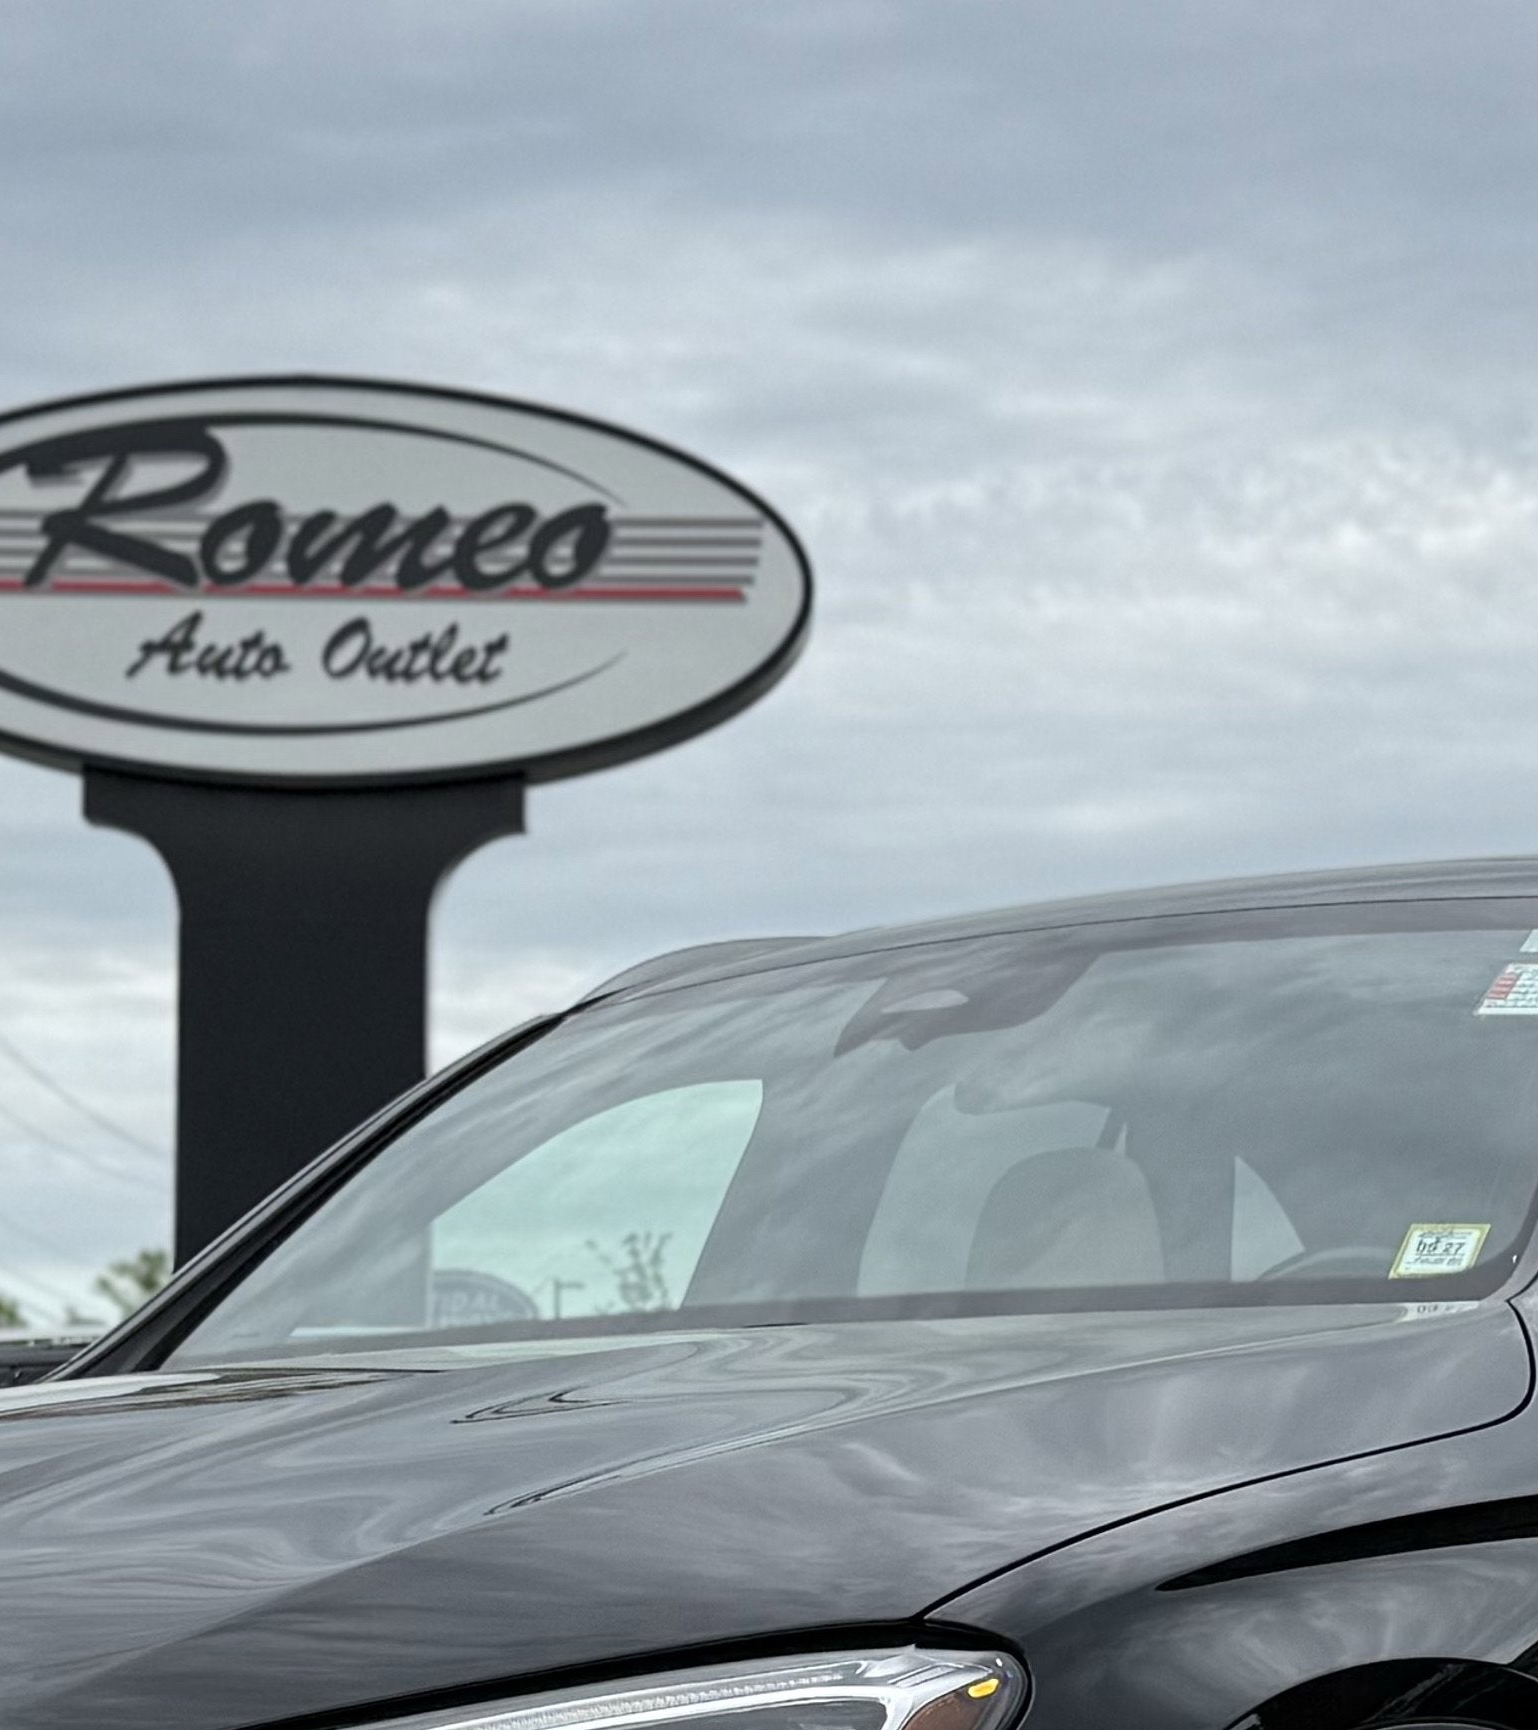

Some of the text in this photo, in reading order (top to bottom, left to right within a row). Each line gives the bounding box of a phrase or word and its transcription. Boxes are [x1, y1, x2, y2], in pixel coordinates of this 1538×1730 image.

[22, 423, 615, 592] Romeo
[125, 609, 510, 688] Auto Outlet
